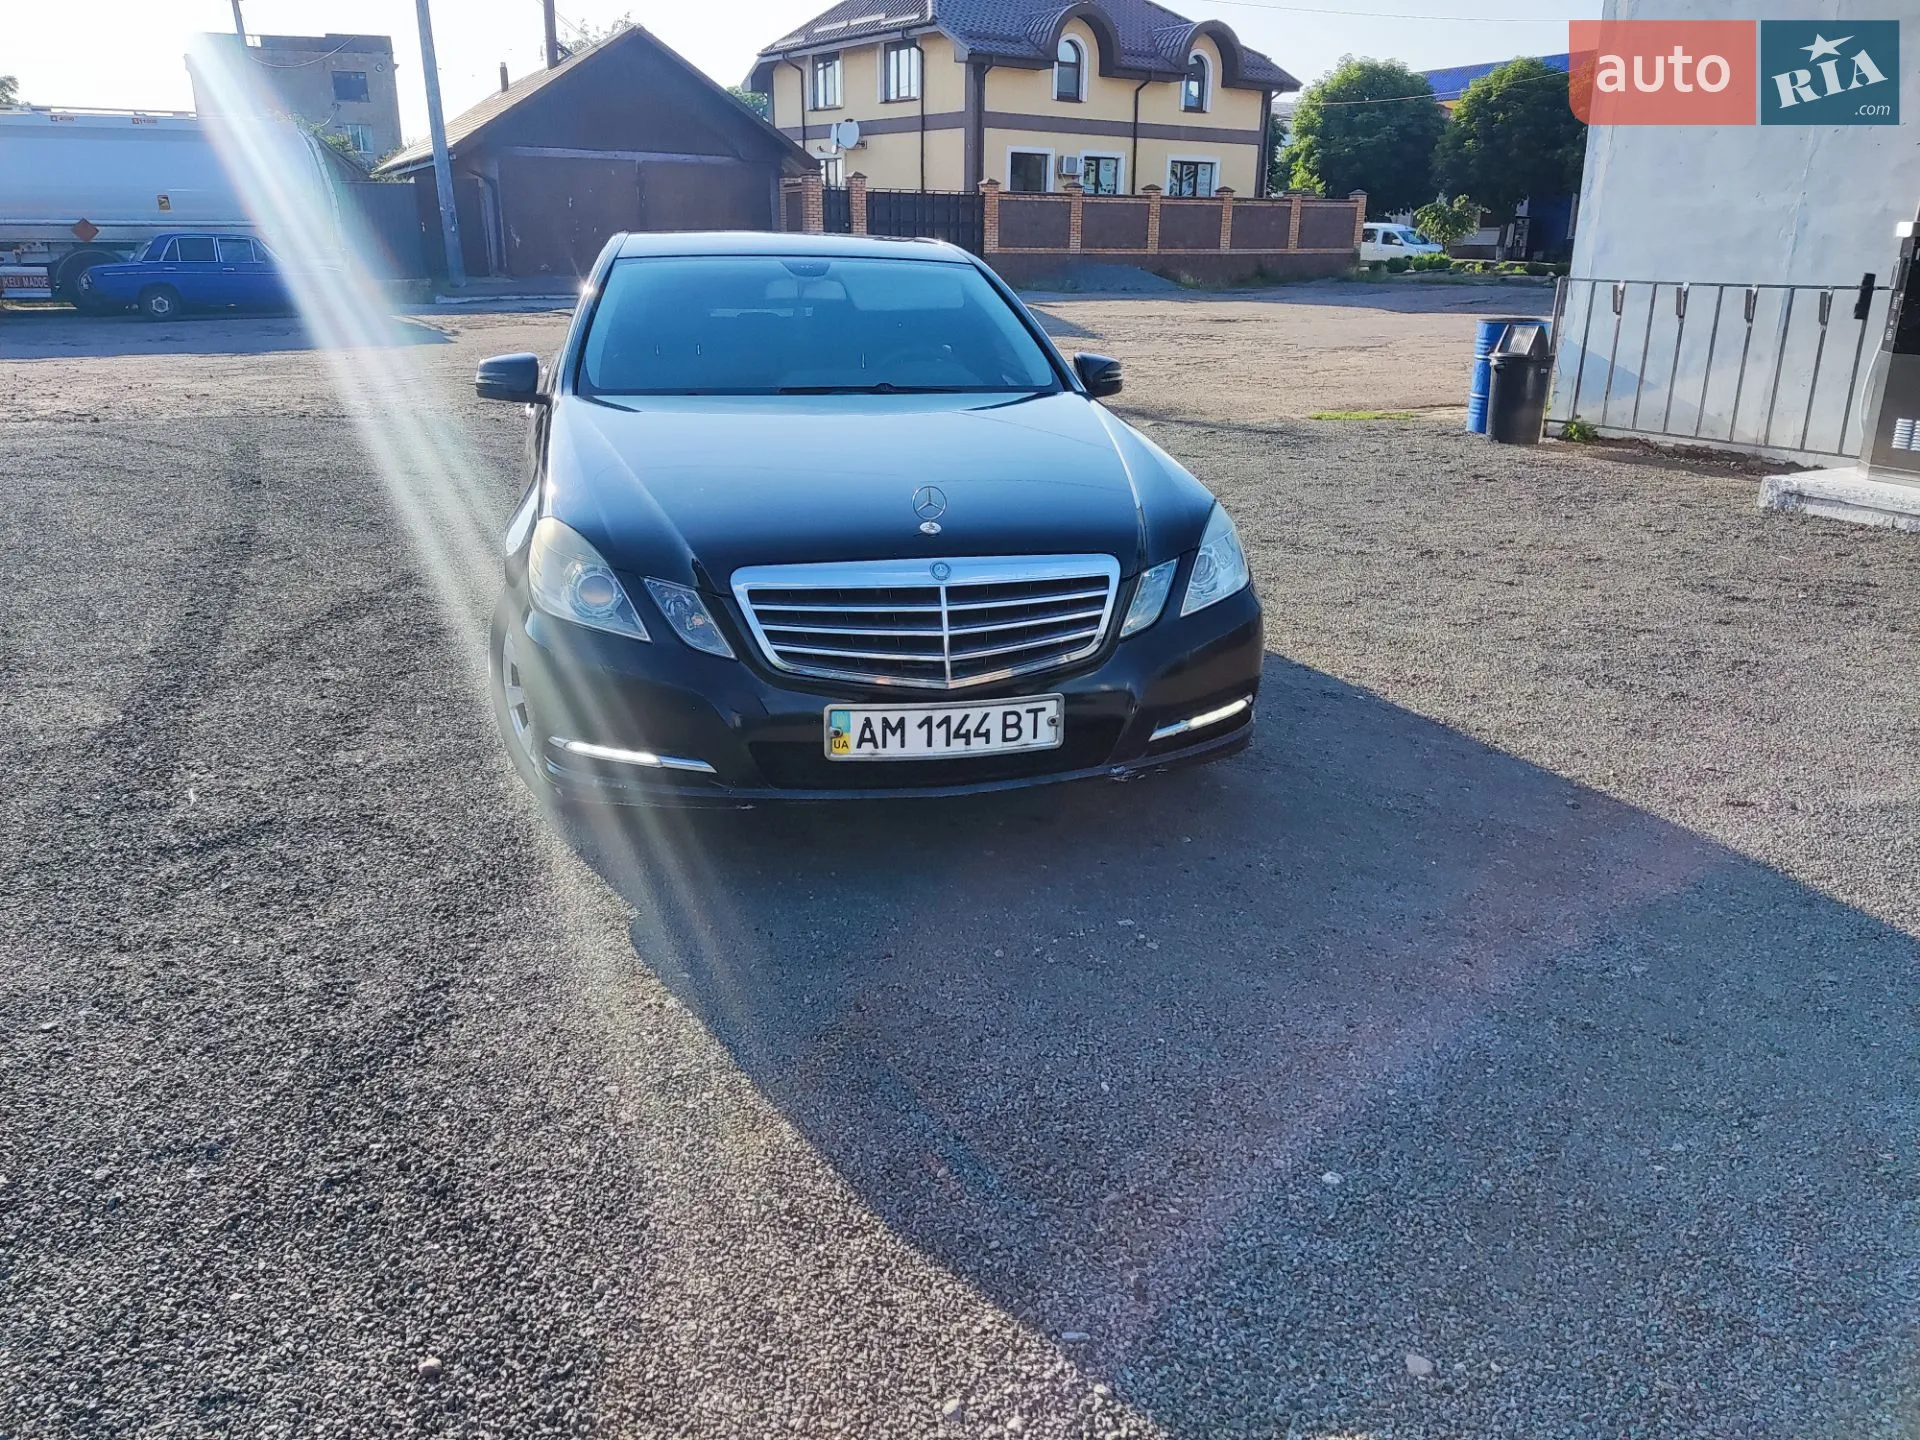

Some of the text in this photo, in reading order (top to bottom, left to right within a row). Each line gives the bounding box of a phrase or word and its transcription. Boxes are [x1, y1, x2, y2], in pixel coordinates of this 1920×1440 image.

[856, 707, 1047, 749] AM 1144 BT
[833, 740, 849, 749] UA
